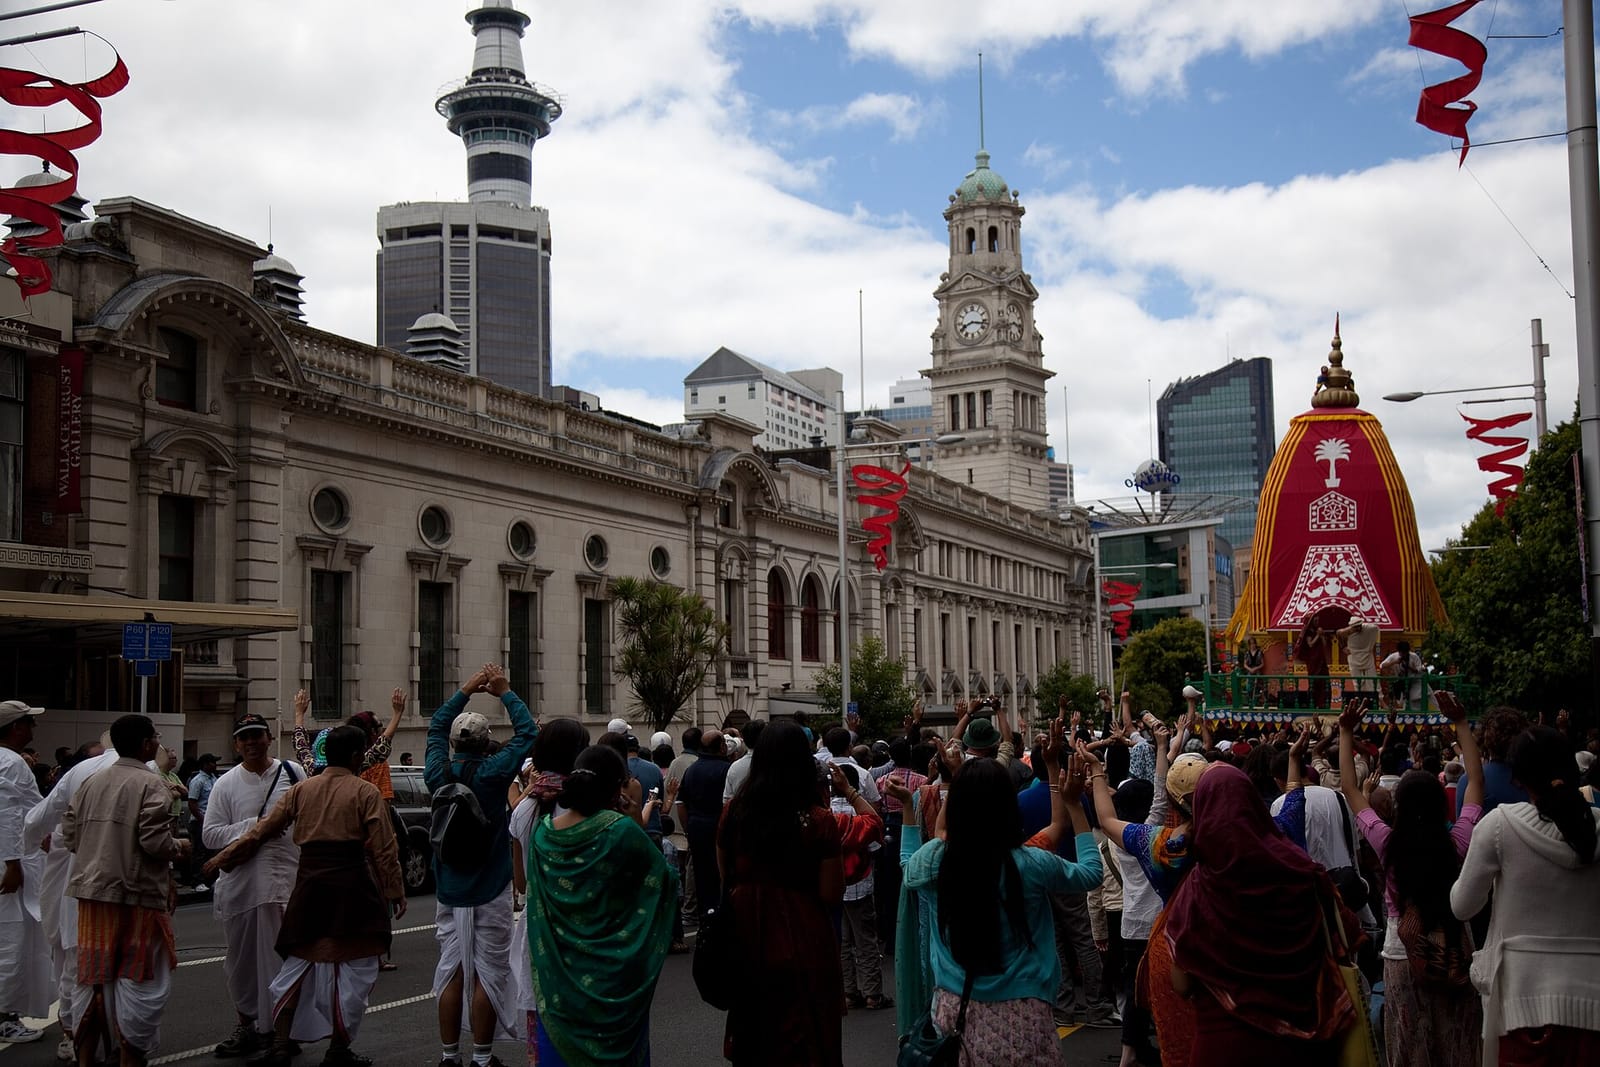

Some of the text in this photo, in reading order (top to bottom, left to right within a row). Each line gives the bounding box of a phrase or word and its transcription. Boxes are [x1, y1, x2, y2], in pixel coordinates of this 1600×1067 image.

[58, 365, 72, 498] WALLACE TRUST
[70, 393, 82, 468] GALLERY
[1134, 472, 1180, 492] METRO
